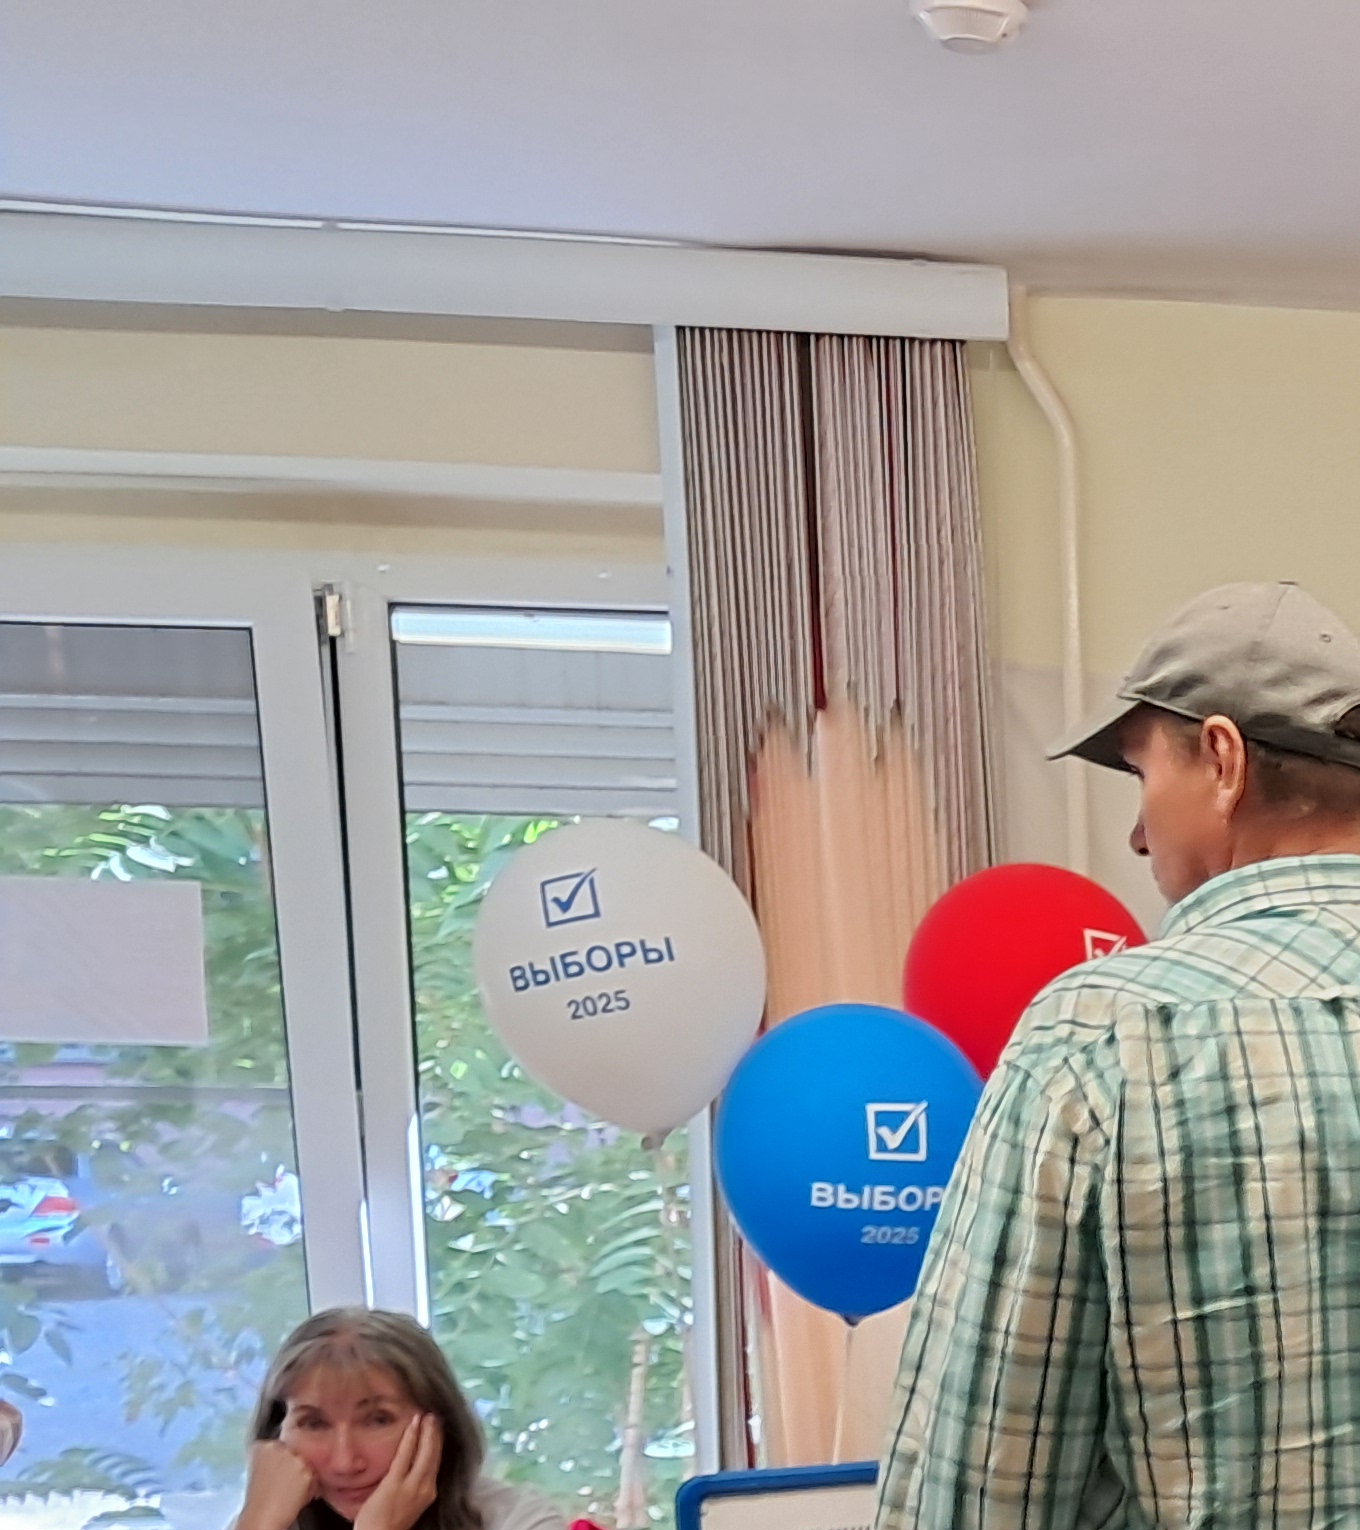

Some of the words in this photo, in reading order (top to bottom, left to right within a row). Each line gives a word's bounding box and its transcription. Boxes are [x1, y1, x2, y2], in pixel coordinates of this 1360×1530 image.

[509, 936, 675, 992] ВЫБОРЫ
[566, 989, 631, 1020] 2025
[860, 1224, 920, 1245] 2025
